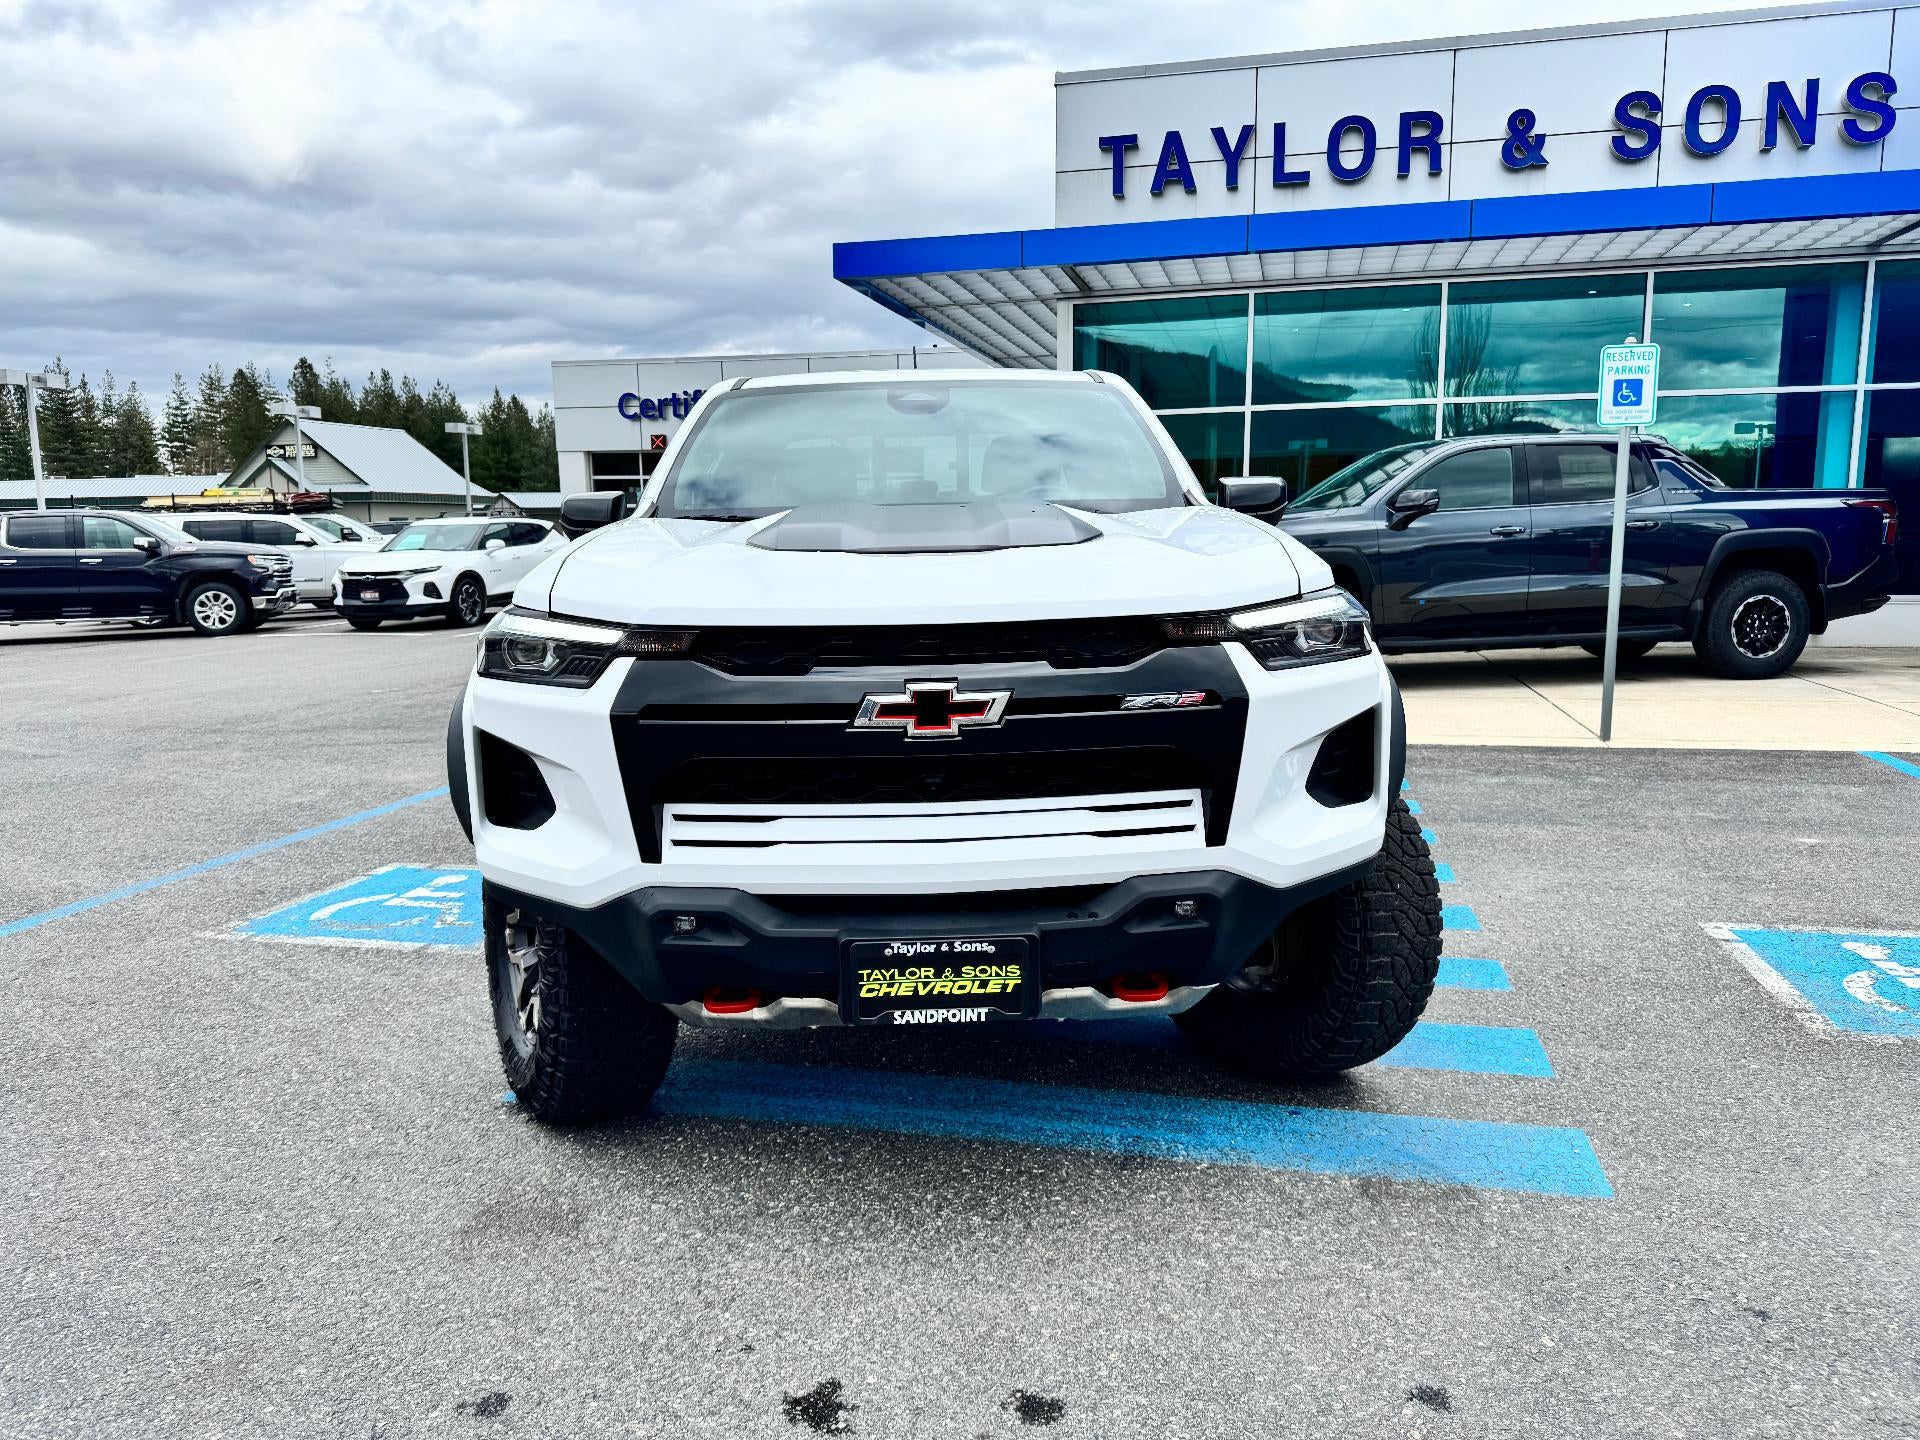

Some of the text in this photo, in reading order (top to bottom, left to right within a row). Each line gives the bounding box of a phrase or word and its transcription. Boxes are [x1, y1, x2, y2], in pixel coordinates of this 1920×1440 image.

[1098, 70, 1899, 199] TAYLOR & SONS
[1605, 350, 1654, 362] RESERVED
[1607, 364, 1651, 376] PARKING
[285, 450, 316, 458] FITESS
[1120, 692, 1206, 710] ZR2
[890, 941, 989, 957] Taylor & Sons
[858, 964, 1021, 982] TAYLOR & SONS
[859, 980, 1022, 998] CHEVROLET
[893, 1008, 989, 1025] SANDPOINT
